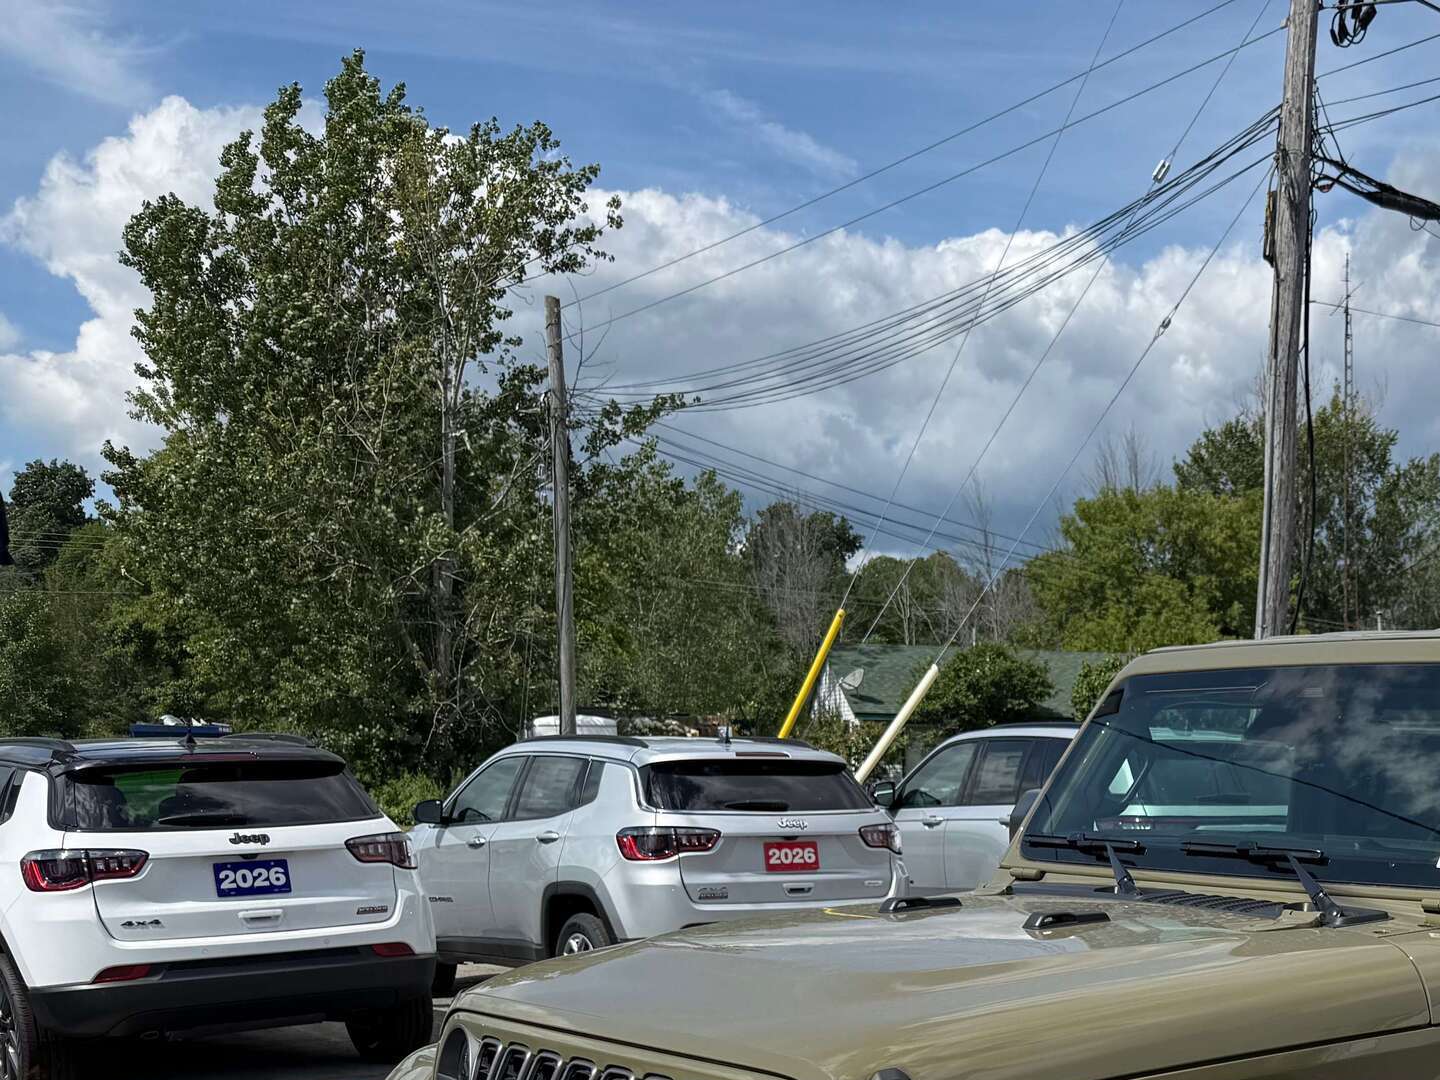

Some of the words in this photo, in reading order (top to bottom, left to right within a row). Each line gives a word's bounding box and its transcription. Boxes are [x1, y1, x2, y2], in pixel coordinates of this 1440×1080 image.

[778, 817, 808, 830] Jeep
[229, 833, 270, 846] Jeep
[768, 847, 817, 865] 2026
[218, 866, 288, 891] 2026
